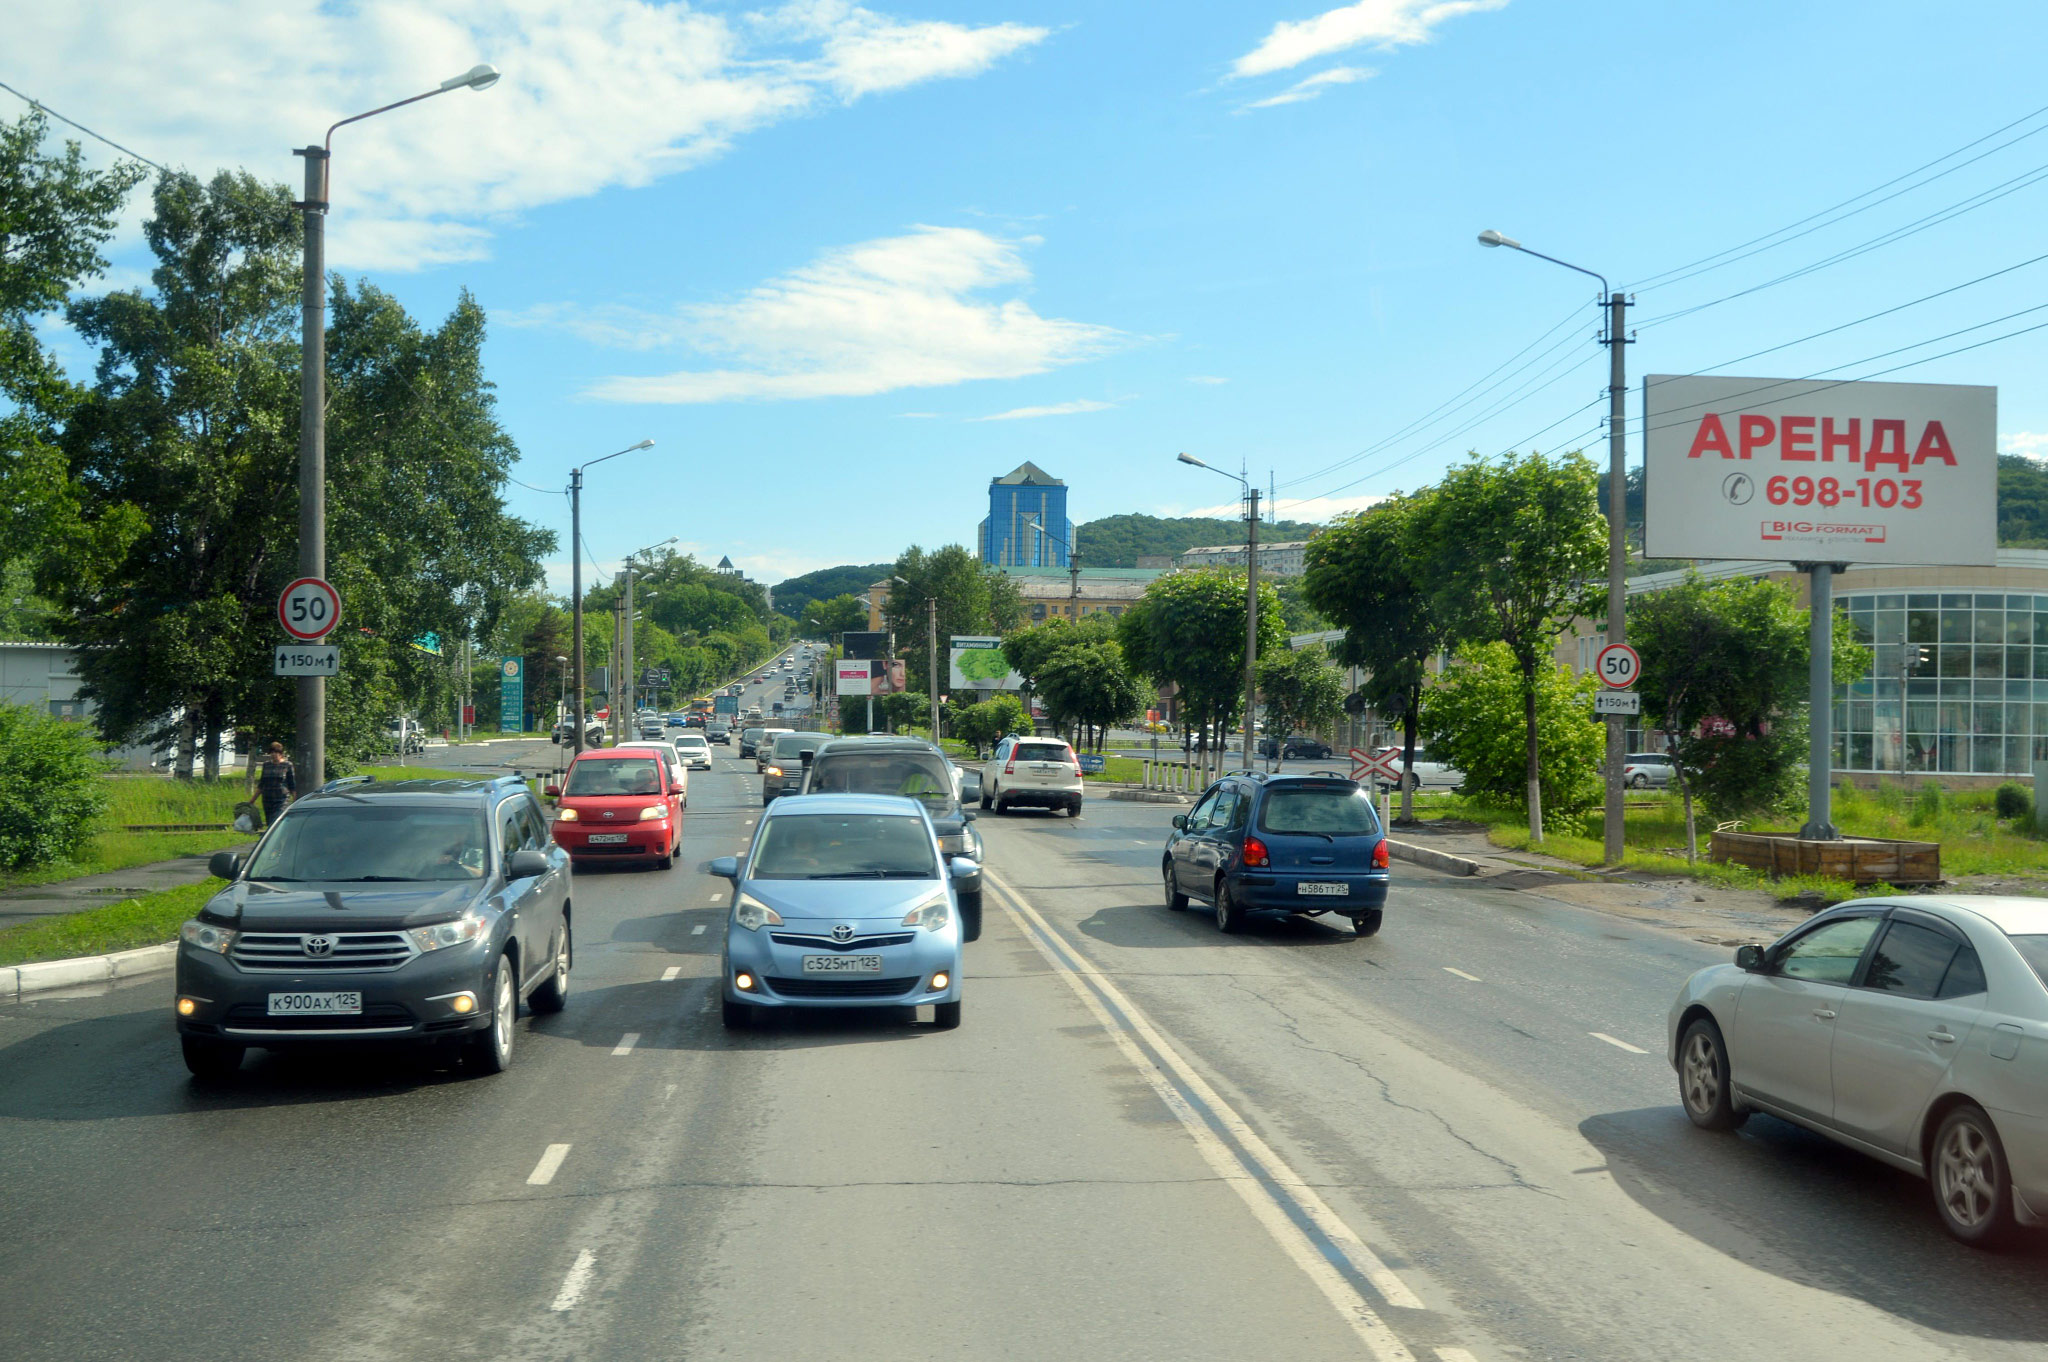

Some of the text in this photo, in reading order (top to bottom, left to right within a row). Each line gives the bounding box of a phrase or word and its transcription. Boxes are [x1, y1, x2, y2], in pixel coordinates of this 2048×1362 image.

[1687, 413, 1958, 473] АРЕНДА
[1766, 475, 1923, 509] 698-103
[1773, 521, 1874, 535] BIG FORMAT
[292, 597, 326, 622] 50
[1606, 657, 1631, 675] 50
[807, 956, 879, 970] С525МТ 125
[273, 993, 358, 1009] К900АХ 125
